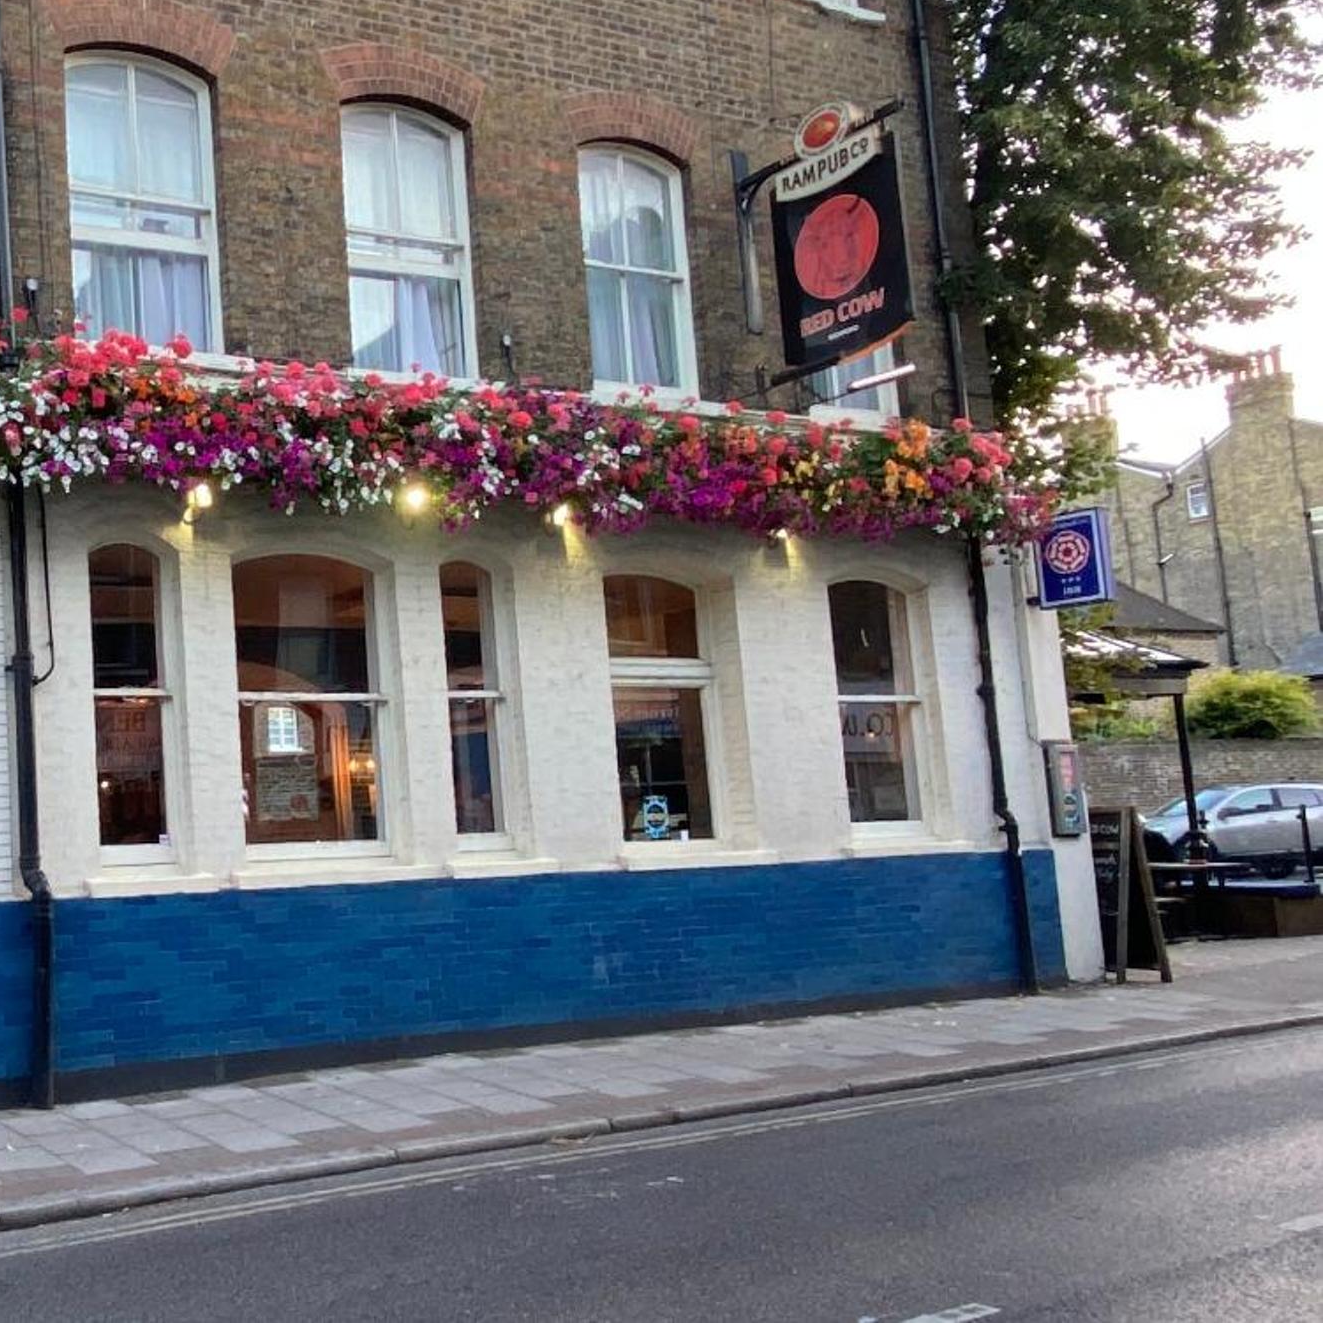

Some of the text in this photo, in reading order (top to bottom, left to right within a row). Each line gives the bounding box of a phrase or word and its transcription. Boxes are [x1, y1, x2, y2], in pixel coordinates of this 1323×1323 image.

[782, 164, 816, 193] RAM
[818, 147, 849, 181] PUB
[799, 308, 835, 338] RED
[837, 286, 886, 322] COW
